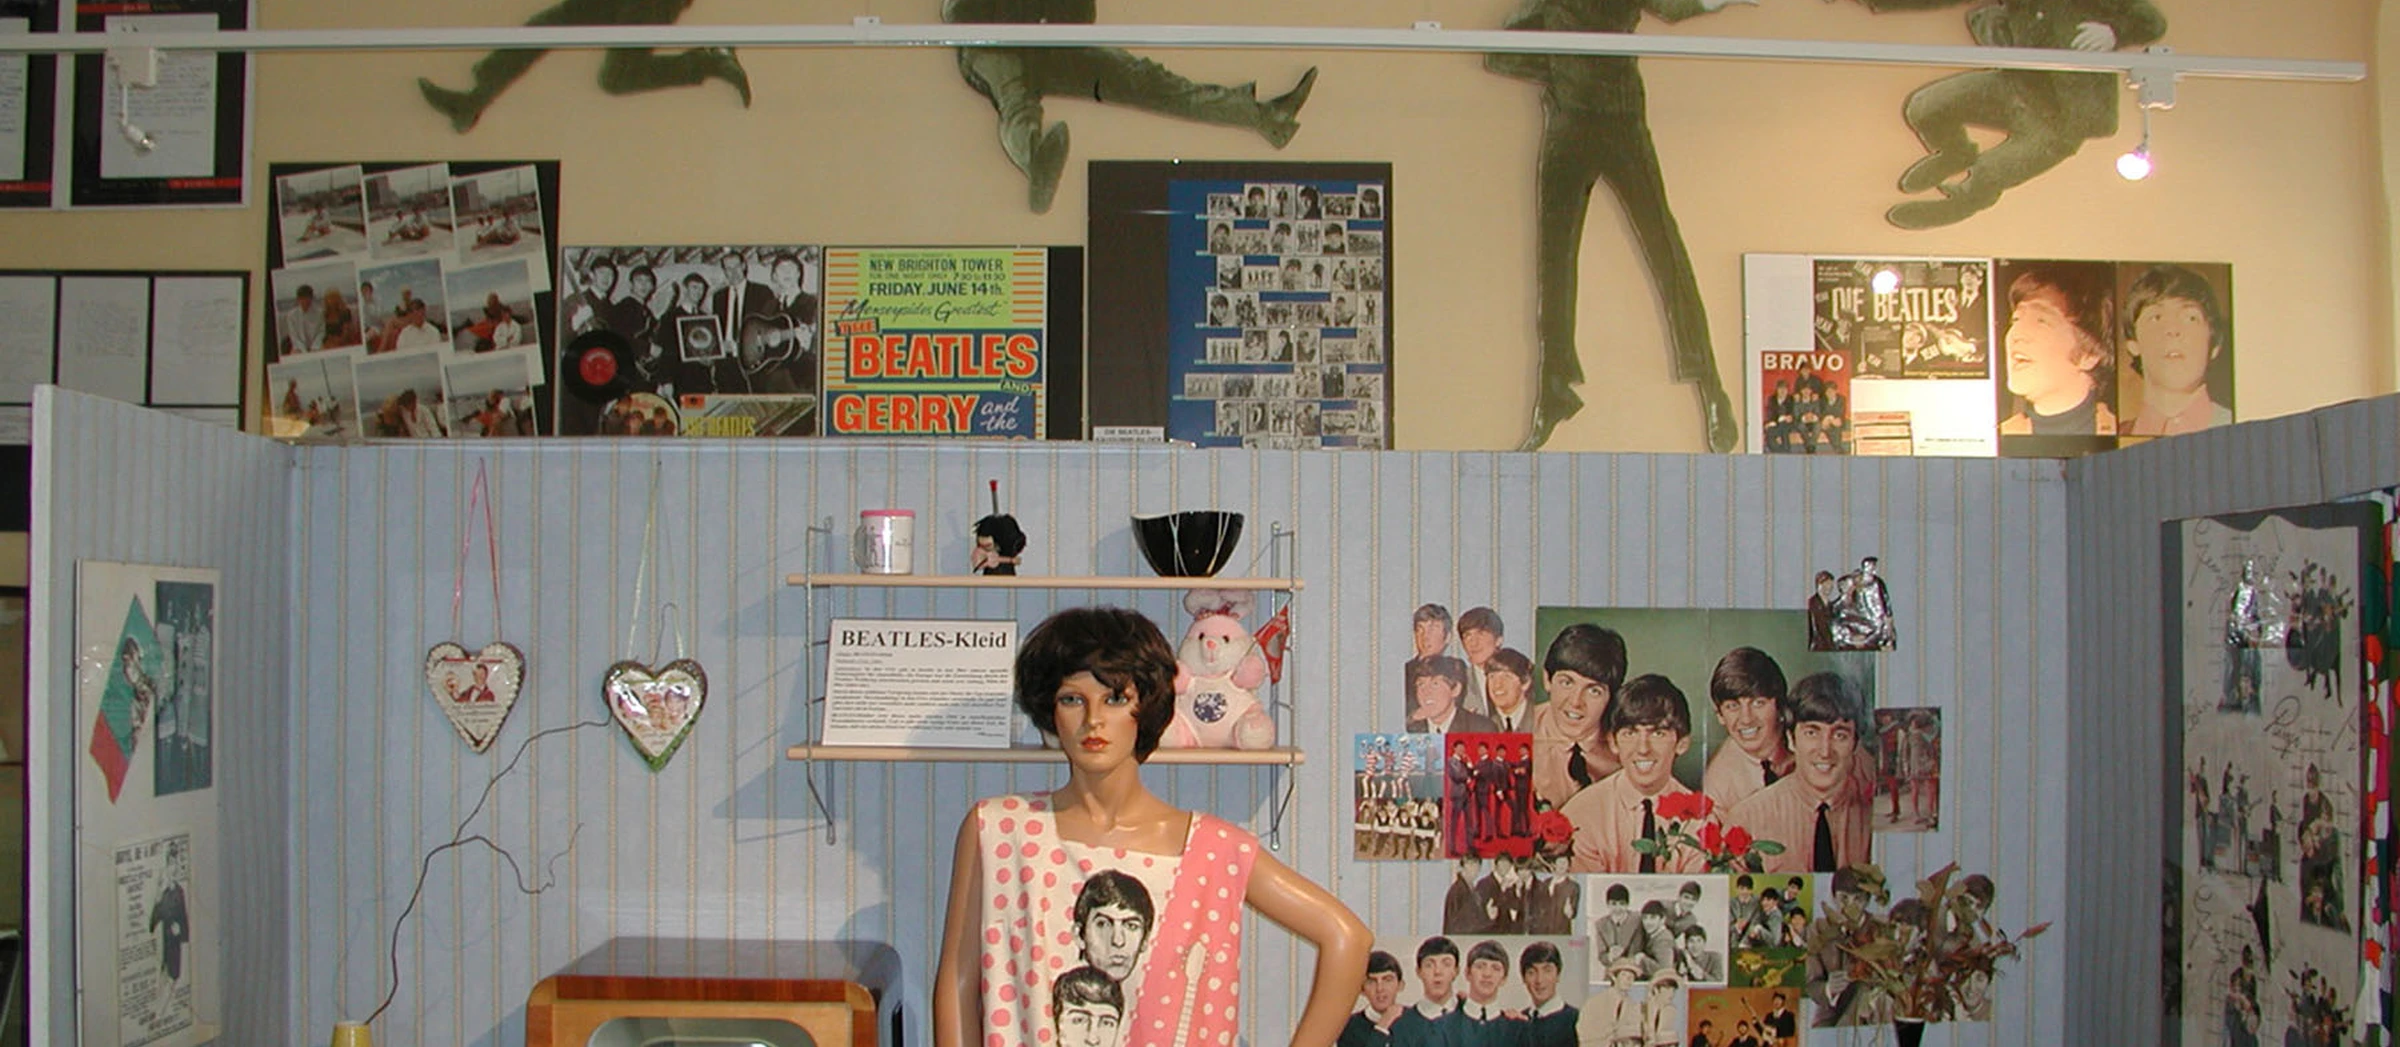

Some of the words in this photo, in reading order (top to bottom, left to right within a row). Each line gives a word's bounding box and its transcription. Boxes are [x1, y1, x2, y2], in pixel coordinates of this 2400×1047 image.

[869, 258, 894, 271] NEW
[898, 258, 957, 271] BRIGHTON
[961, 258, 1004, 271] TOWER
[927, 282, 968, 296] JUNE
[1832, 287, 1865, 322] DIE
[1873, 287, 1958, 322] BEATLES
[851, 334, 1039, 379] BEATLES
[1763, 353, 1844, 371] BRAVO
[1001, 380, 1029, 393] AND
[833, 394, 981, 434] GERRY
[981, 396, 1020, 415] and
[980, 412, 1018, 432] the
[842, 630, 1007, 649] BEATLES-Kleid
